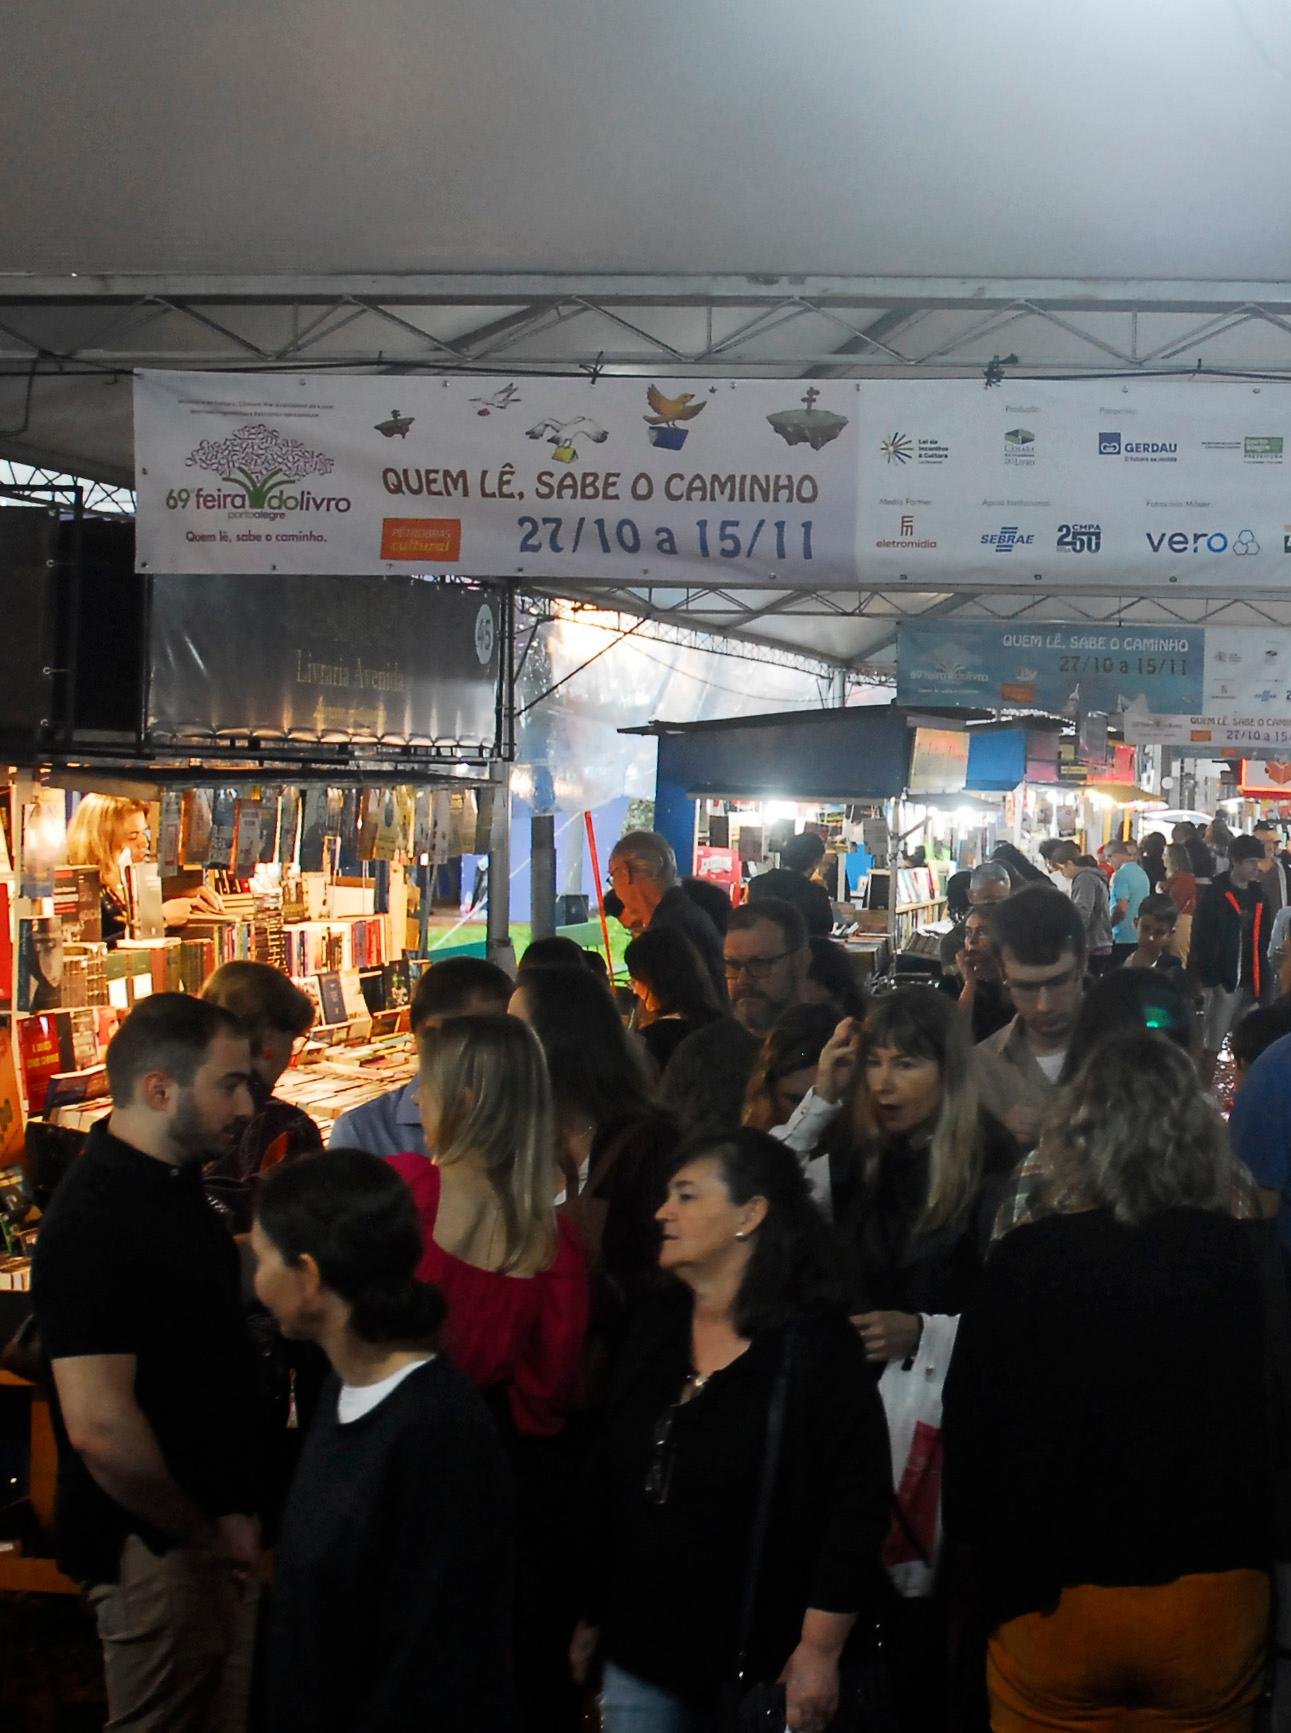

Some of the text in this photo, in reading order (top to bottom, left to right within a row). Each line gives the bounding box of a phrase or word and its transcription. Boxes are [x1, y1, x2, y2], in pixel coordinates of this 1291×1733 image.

[1124, 443, 1178, 453] GERDAU
[382, 462, 819, 504] QUEM LÊ, SABE O CAMINHO
[195, 488, 247, 511] feira
[1072, 523, 1101, 531] CMPA
[186, 531, 216, 543] Quem
[236, 530, 262, 543] sabe
[265, 534, 272, 542] o
[275, 530, 328, 543] caminho.
[517, 516, 814, 560] 27/10 a 15/11
[876, 538, 937, 549] eletromidia
[980, 534, 1035, 545] SEBRAE
[1146, 532, 1228, 554] vero
[1003, 634, 1043, 648] QUEM
[1070, 636, 1106, 650] SABE
[1110, 637, 1120, 650] O
[1123, 638, 1190, 653] CAMINHO
[1059, 655, 1187, 677] 27/10 a 15/11
[1226, 730, 1261, 741] 27/10
